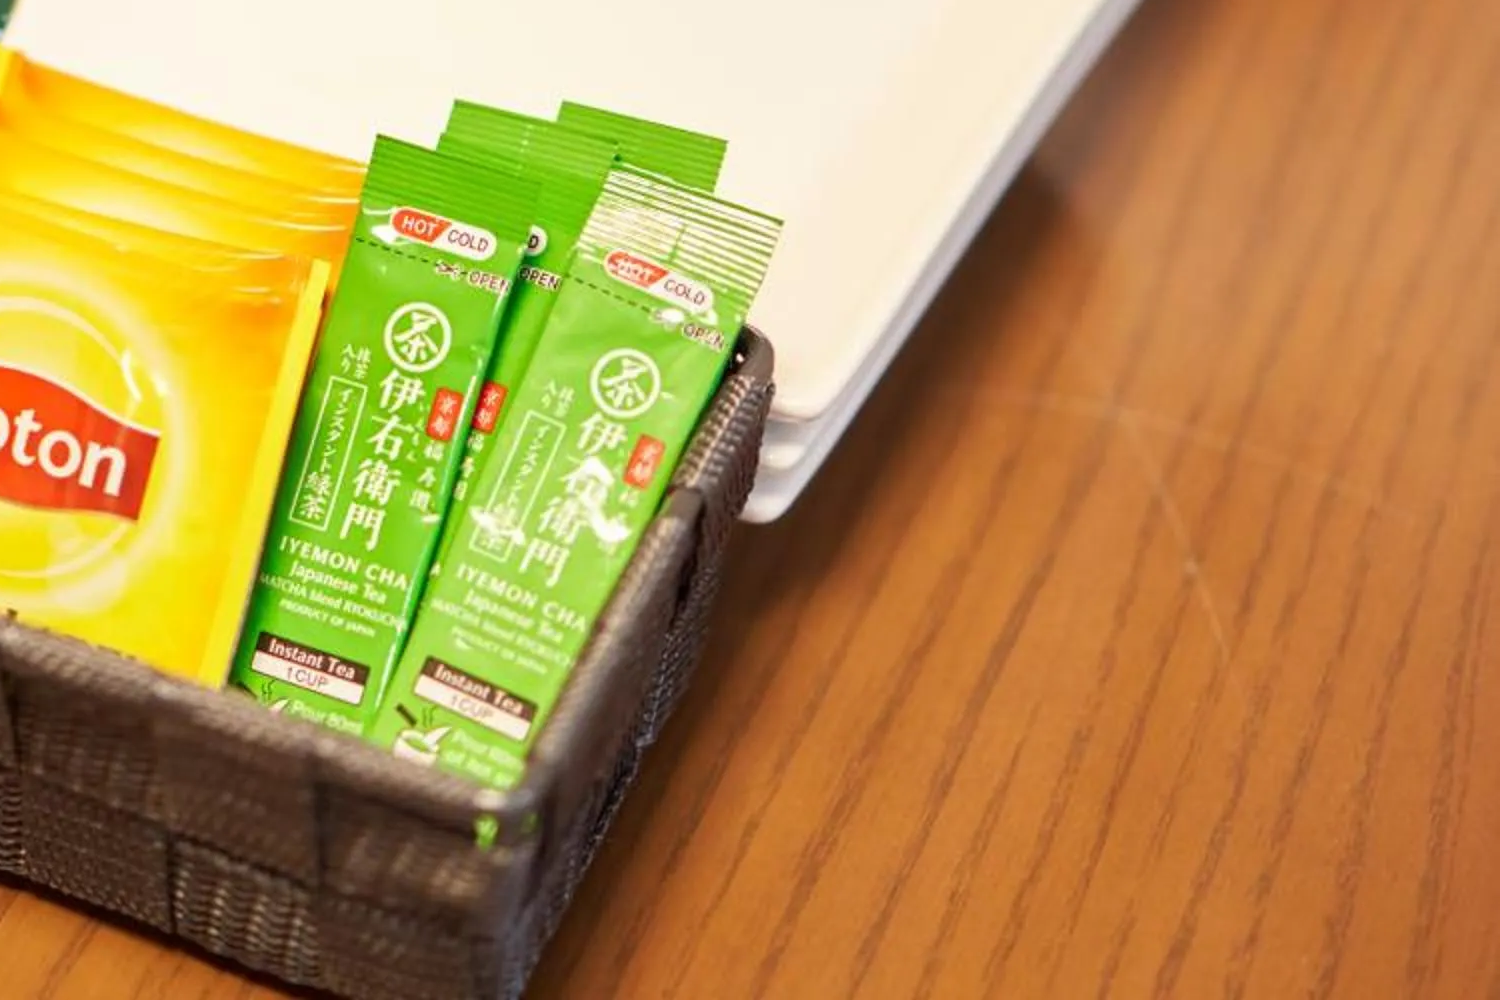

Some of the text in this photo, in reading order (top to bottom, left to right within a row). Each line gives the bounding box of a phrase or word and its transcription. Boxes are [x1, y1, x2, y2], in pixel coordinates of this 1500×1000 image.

[401, 215, 490, 253] HOT COLD
[469, 270, 510, 294] OPEN
[519, 267, 560, 291] OPEN
[663, 278, 706, 306] COLD
[339, 368, 427, 551] 伊右衛門
[279, 535, 408, 591] IYEMON CHA
[288, 560, 388, 604] Japanese Tea
[457, 562, 587, 632] IYEMON CHA
[268, 637, 356, 680] Instant Tea
[433, 663, 526, 717] Instant Tea
